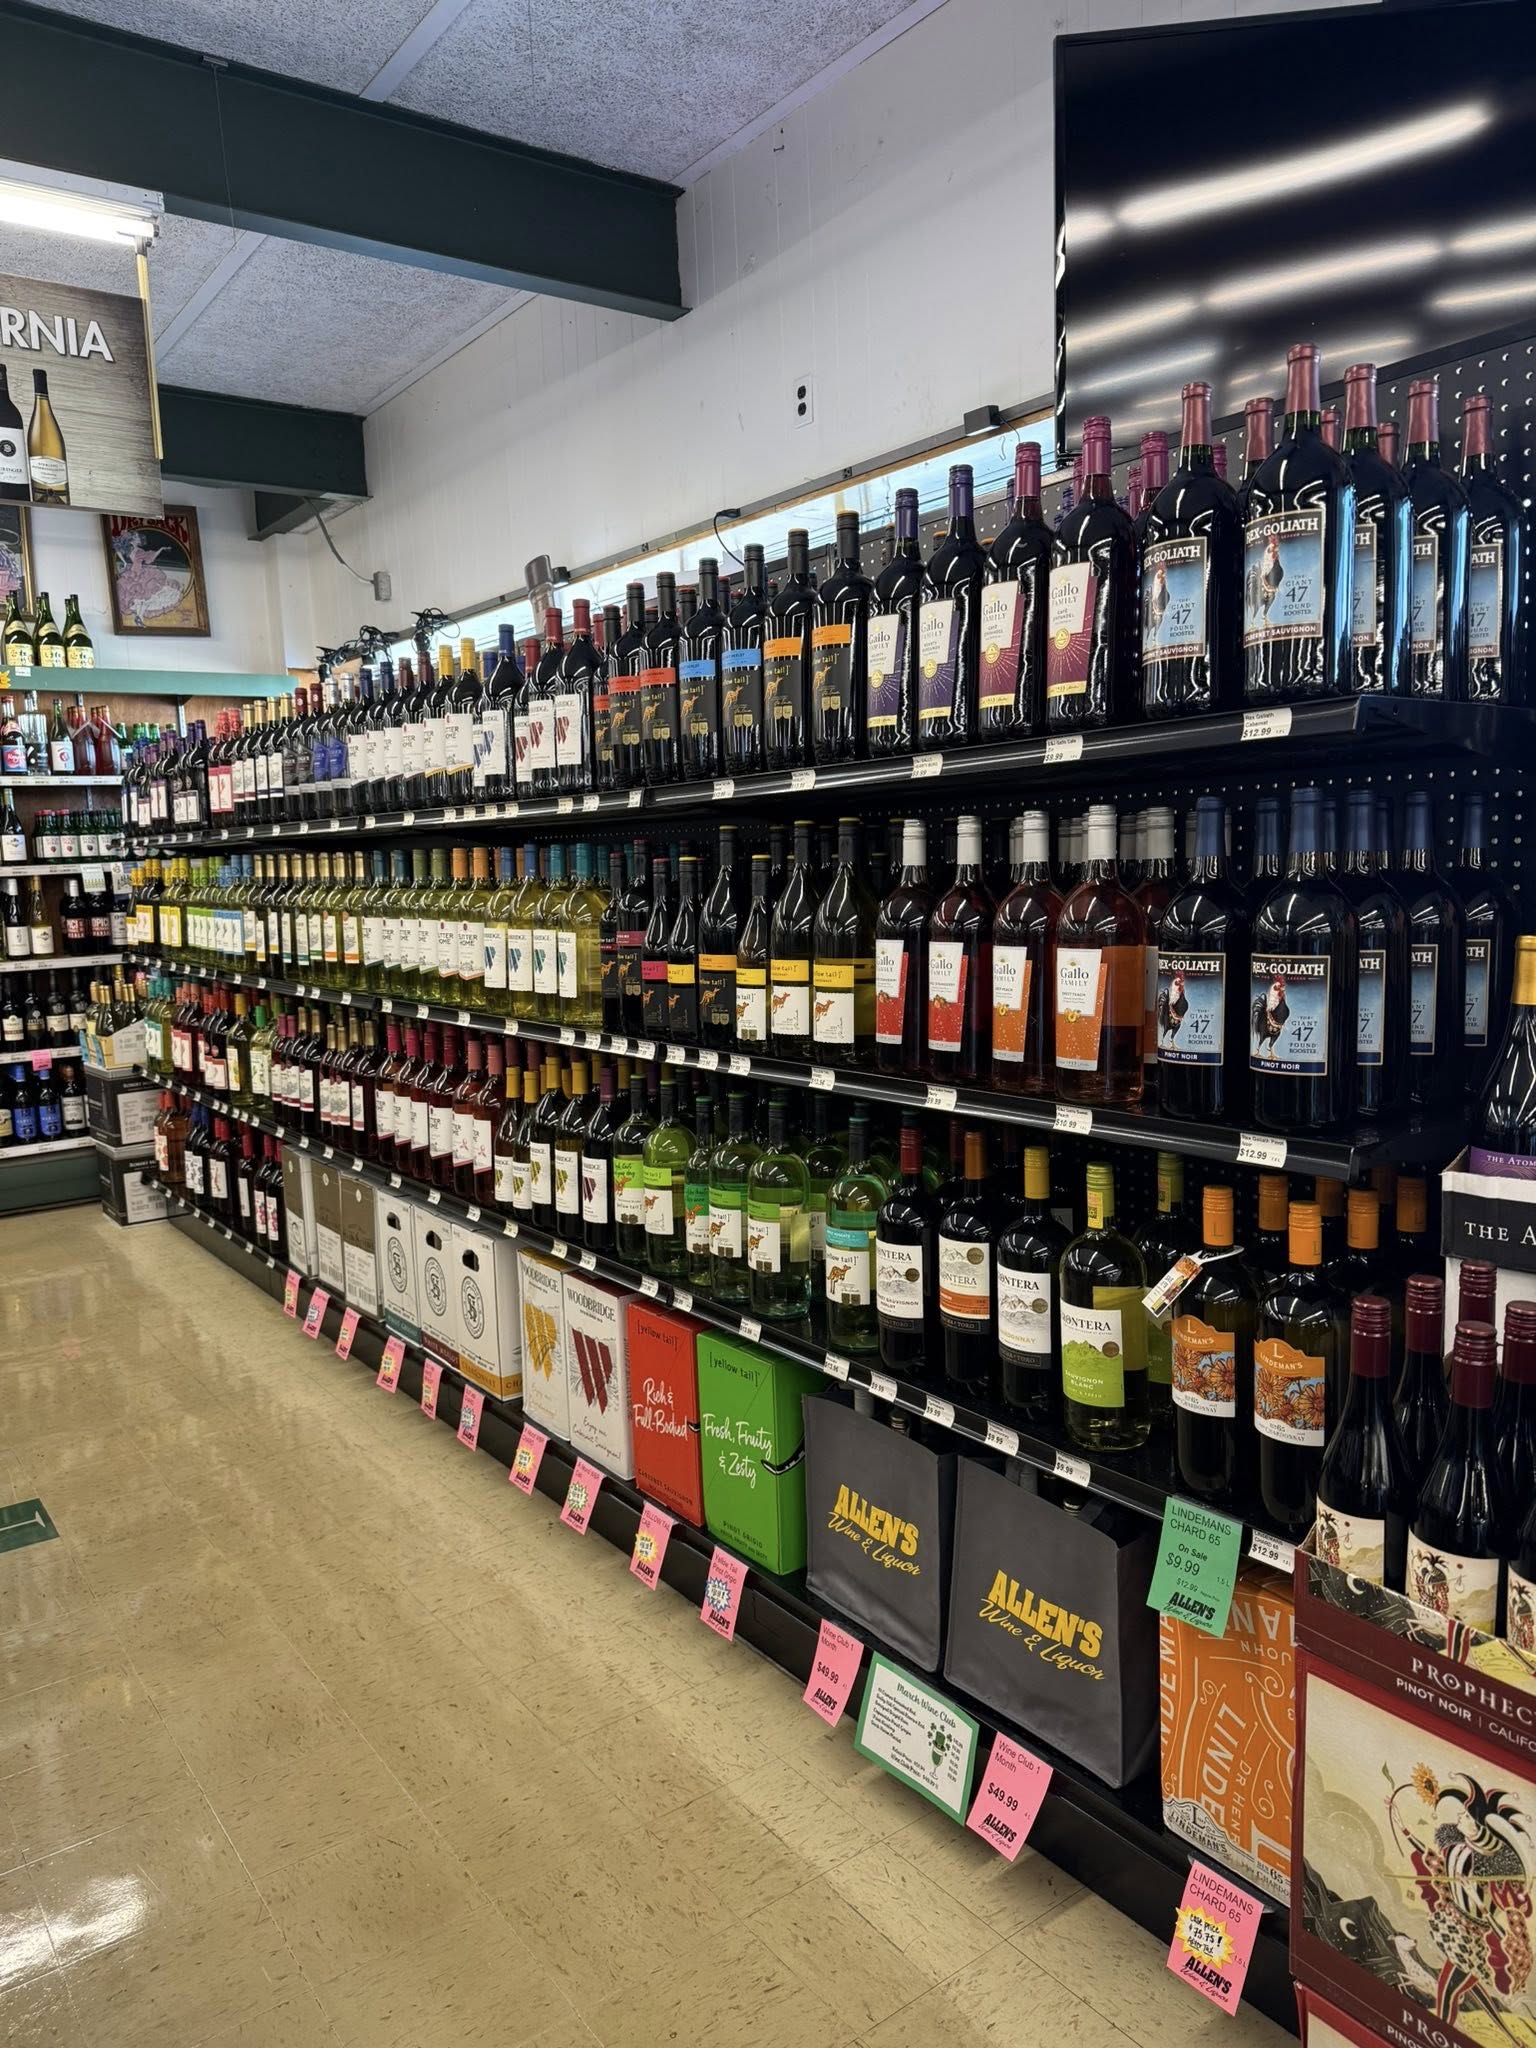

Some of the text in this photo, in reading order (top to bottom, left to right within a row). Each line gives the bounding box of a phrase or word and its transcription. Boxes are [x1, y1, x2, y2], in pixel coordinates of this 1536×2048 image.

[0, 306, 114, 362] RNIA
[1051, 582, 1080, 599] Gallo
[1286, 579, 1312, 587] GIANT
[1286, 586, 1309, 603] 47
[983, 601, 1008, 617] Gallo
[1171, 602, 1195, 610] GIANT
[1284, 602, 1312, 610] POUND
[921, 619, 944, 633] Gallo
[1171, 609, 1192, 625] 47
[1170, 624, 1194, 632] POUND
[1170, 630, 1195, 638] ROOSTER
[1271, 625, 1316, 636] SAUVIGNON
[1243, 727, 1272, 738] $12.99
[930, 957, 953, 970] Gallo
[993, 962, 1016, 976] Gallo
[1060, 966, 1089, 980] Gallo
[1060, 978, 1088, 987] FAMILY
[1190, 1019, 1210, 1034] 47
[1291, 1026, 1314, 1042] 47
[1260, 1061, 1300, 1070] PINOT NOIR
[1055, 1118, 1077, 1128] $10.99
[1239, 1148, 1267, 1160] $12.99
[1487, 1155, 1504, 1163] THE
[1464, 1221, 1536, 1246] THE A
[567, 1287, 617, 1323] WOODBRIDGE
[1187, 1319, 1197, 1334] L
[1175, 1329, 1215, 1345] LINDEMAN'S
[1273, 1342, 1284, 1358] L
[1260, 1352, 1304, 1371] LINDEMAN'S
[1065, 1369, 1104, 1385] SAUVIGNON
[1070, 1379, 1094, 1390] BLANC
[643, 1378, 667, 1405] Rich
[926, 1404, 941, 1418] $9.99
[633, 1403, 689, 1441] Full-Bodied
[702, 1413, 773, 1460] Fresh, Fruity
[987, 1431, 1003, 1446] $9.99
[719, 1450, 757, 1488] & Zesty
[1056, 1462, 1074, 1476] $9.99
[833, 1483, 920, 1556] ALLEN'S
[1172, 1505, 1232, 1536] LINDEMANS
[1170, 1518, 1222, 1546] CHARD 65
[828, 1511, 921, 1576] Wine & Liquor
[1254, 1536, 1271, 1548] CHARD
[1178, 1543, 1208, 1562] On Sale
[1252, 1543, 1279, 1561] $12.99
[1166, 1552, 1201, 1576] $9.99
[1176, 1577, 1199, 1592] $12.99
[988, 1568, 1104, 1658] ALLEN'S
[1168, 1591, 1216, 1621] ALLEN'S
[822, 1625, 850, 1649] Wine Club
[979, 1598, 1105, 1681] Wine & Liquor
[816, 1661, 839, 1684] $49.99
[1396, 1677, 1434, 1703] PINOT
[1439, 1698, 1472, 1722] NOIR
[1411, 1656, 1536, 1726] PROPHEC
[896, 1682, 957, 1729] March Wine Club
[995, 1752, 1017, 1773] Month
[999, 1740, 1034, 1772] Wine Club
[1235, 1759, 1252, 1787] DR
[987, 1781, 1019, 1812] $49.99
[983, 1813, 1018, 1843] ALLEN'S
[1170, 1811, 1228, 1854] LINDEMAN'S
[1270, 1867, 1284, 1885] 65
[1193, 1868, 1254, 1915] LINDEMANS
[1189, 1883, 1242, 1923] CHARD 65
[1185, 1955, 1232, 1995] ALLEN'S
